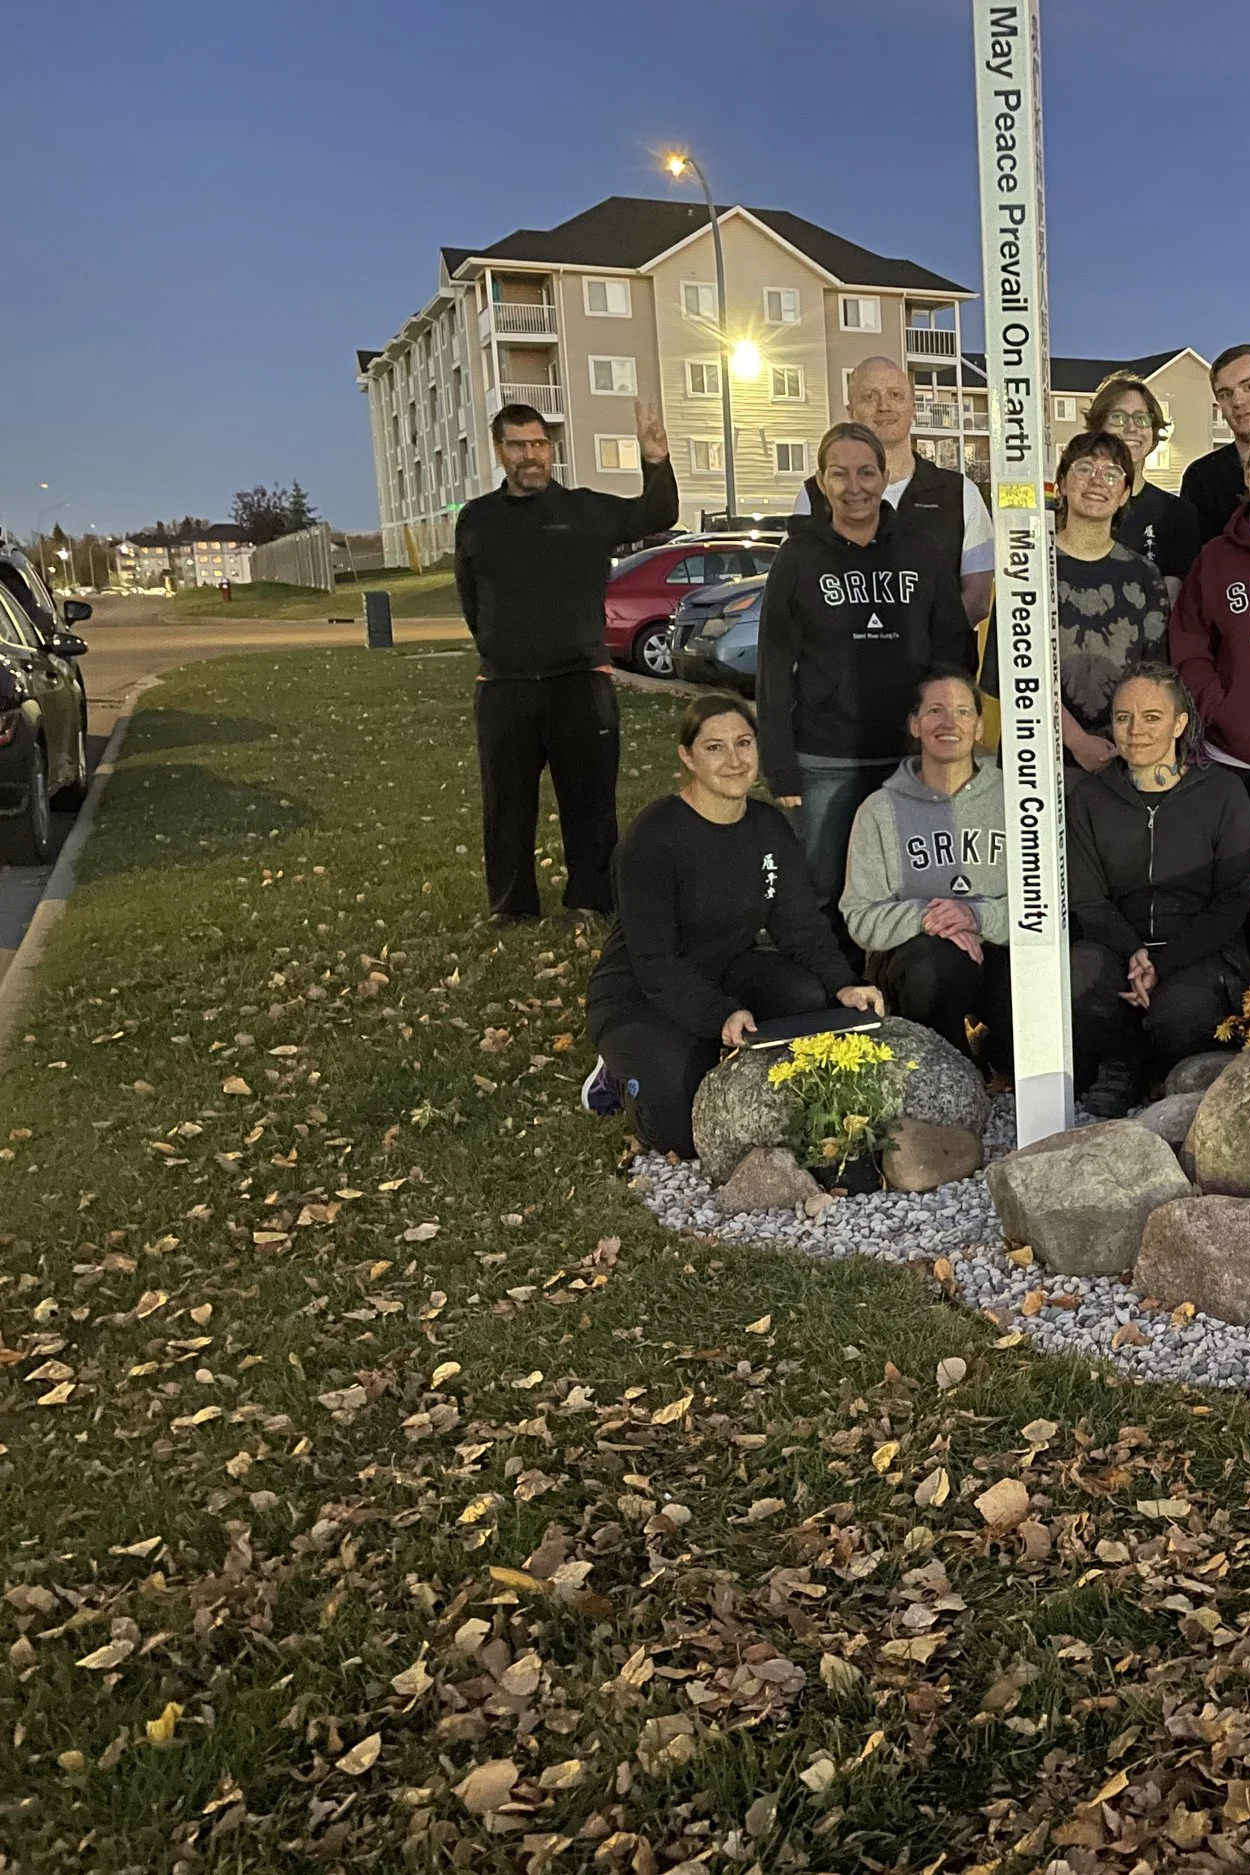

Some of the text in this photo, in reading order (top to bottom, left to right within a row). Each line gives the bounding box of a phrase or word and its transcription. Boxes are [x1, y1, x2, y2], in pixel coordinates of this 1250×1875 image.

[988, 5, 1018, 79] May
[994, 89, 1022, 193] Peace
[998, 203, 1027, 313] Prevail
[1002, 323, 1030, 366] On
[1004, 377, 1032, 462] Earth
[1004, 529, 1035, 582] May
[1048, 529, 1057, 604] Puisse
[819, 571, 919, 606] SRKF
[1011, 591, 1038, 669] Peace
[1049, 611, 1058, 630] la
[1050, 638, 1060, 684] paix
[1014, 678, 1040, 709] Be
[1016, 719, 1042, 739] in
[1017, 748, 1038, 789] our
[1056, 772, 1065, 825] dans
[906, 829, 1006, 871] SRKF
[1018, 796, 1047, 934] Community
[1058, 831, 1066, 849] le
[1059, 855, 1068, 931] monde
